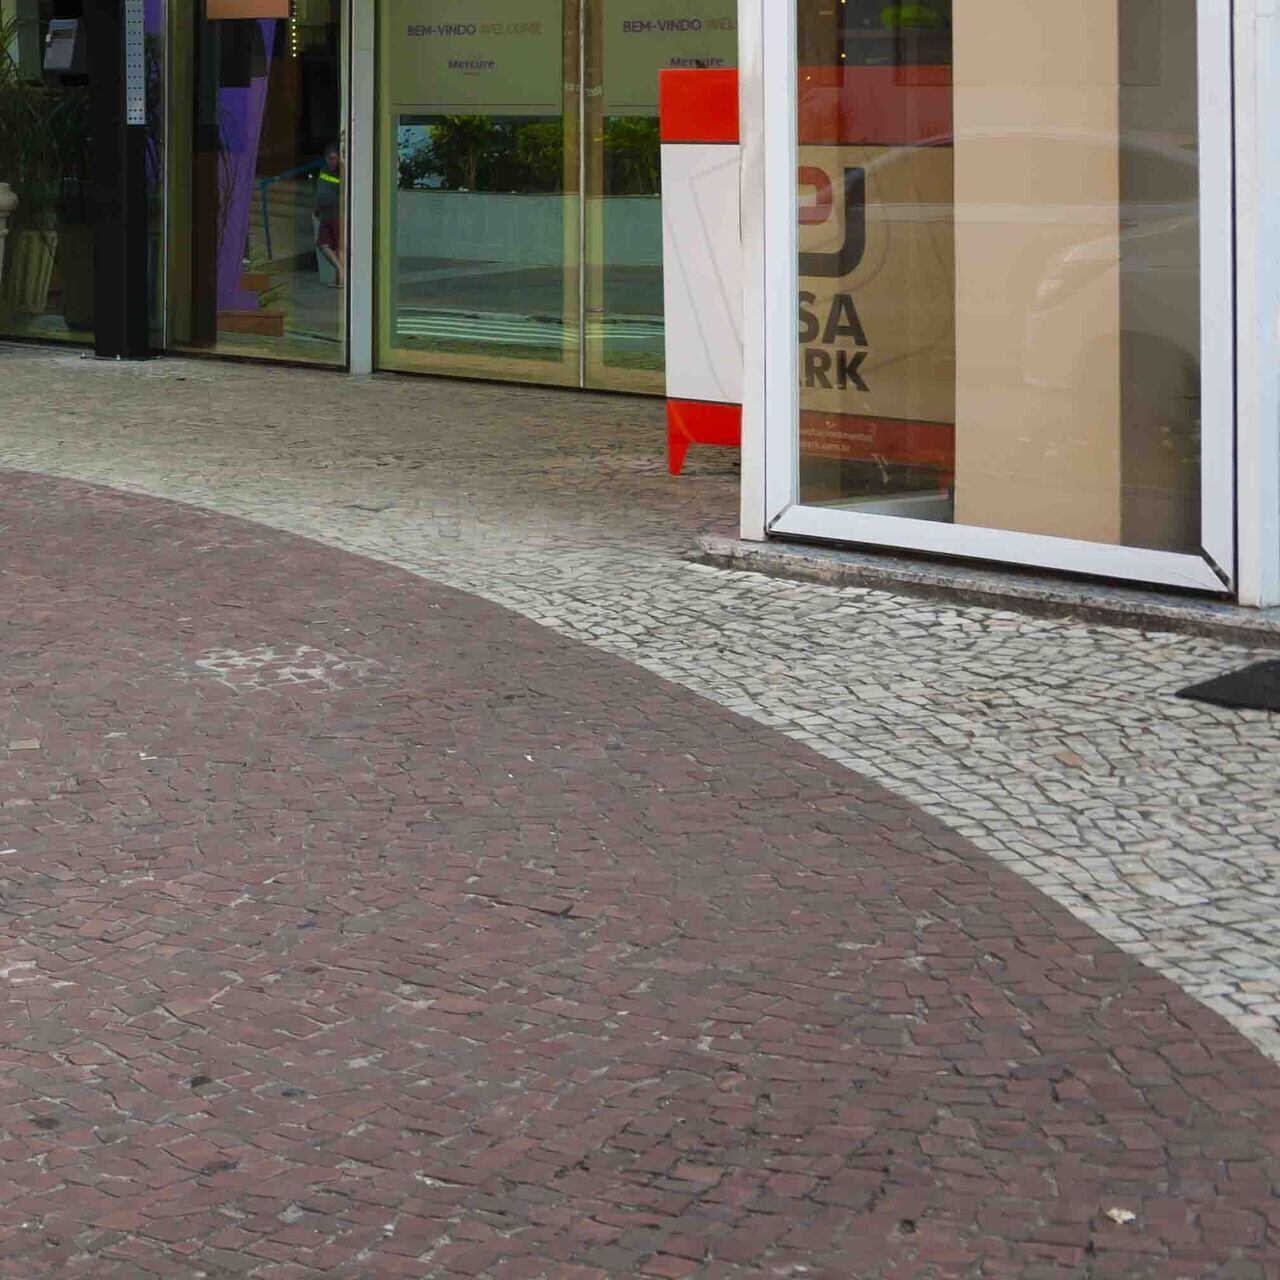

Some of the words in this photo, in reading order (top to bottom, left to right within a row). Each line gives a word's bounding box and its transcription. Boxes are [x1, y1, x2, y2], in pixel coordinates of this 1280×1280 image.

[407, 24, 477, 37] BEM-VINDO
[623, 19, 702, 33] BEM-VINDO
[448, 59, 496, 70] Mercure
[798, 290, 869, 347] SA
[799, 348, 870, 393] RK
